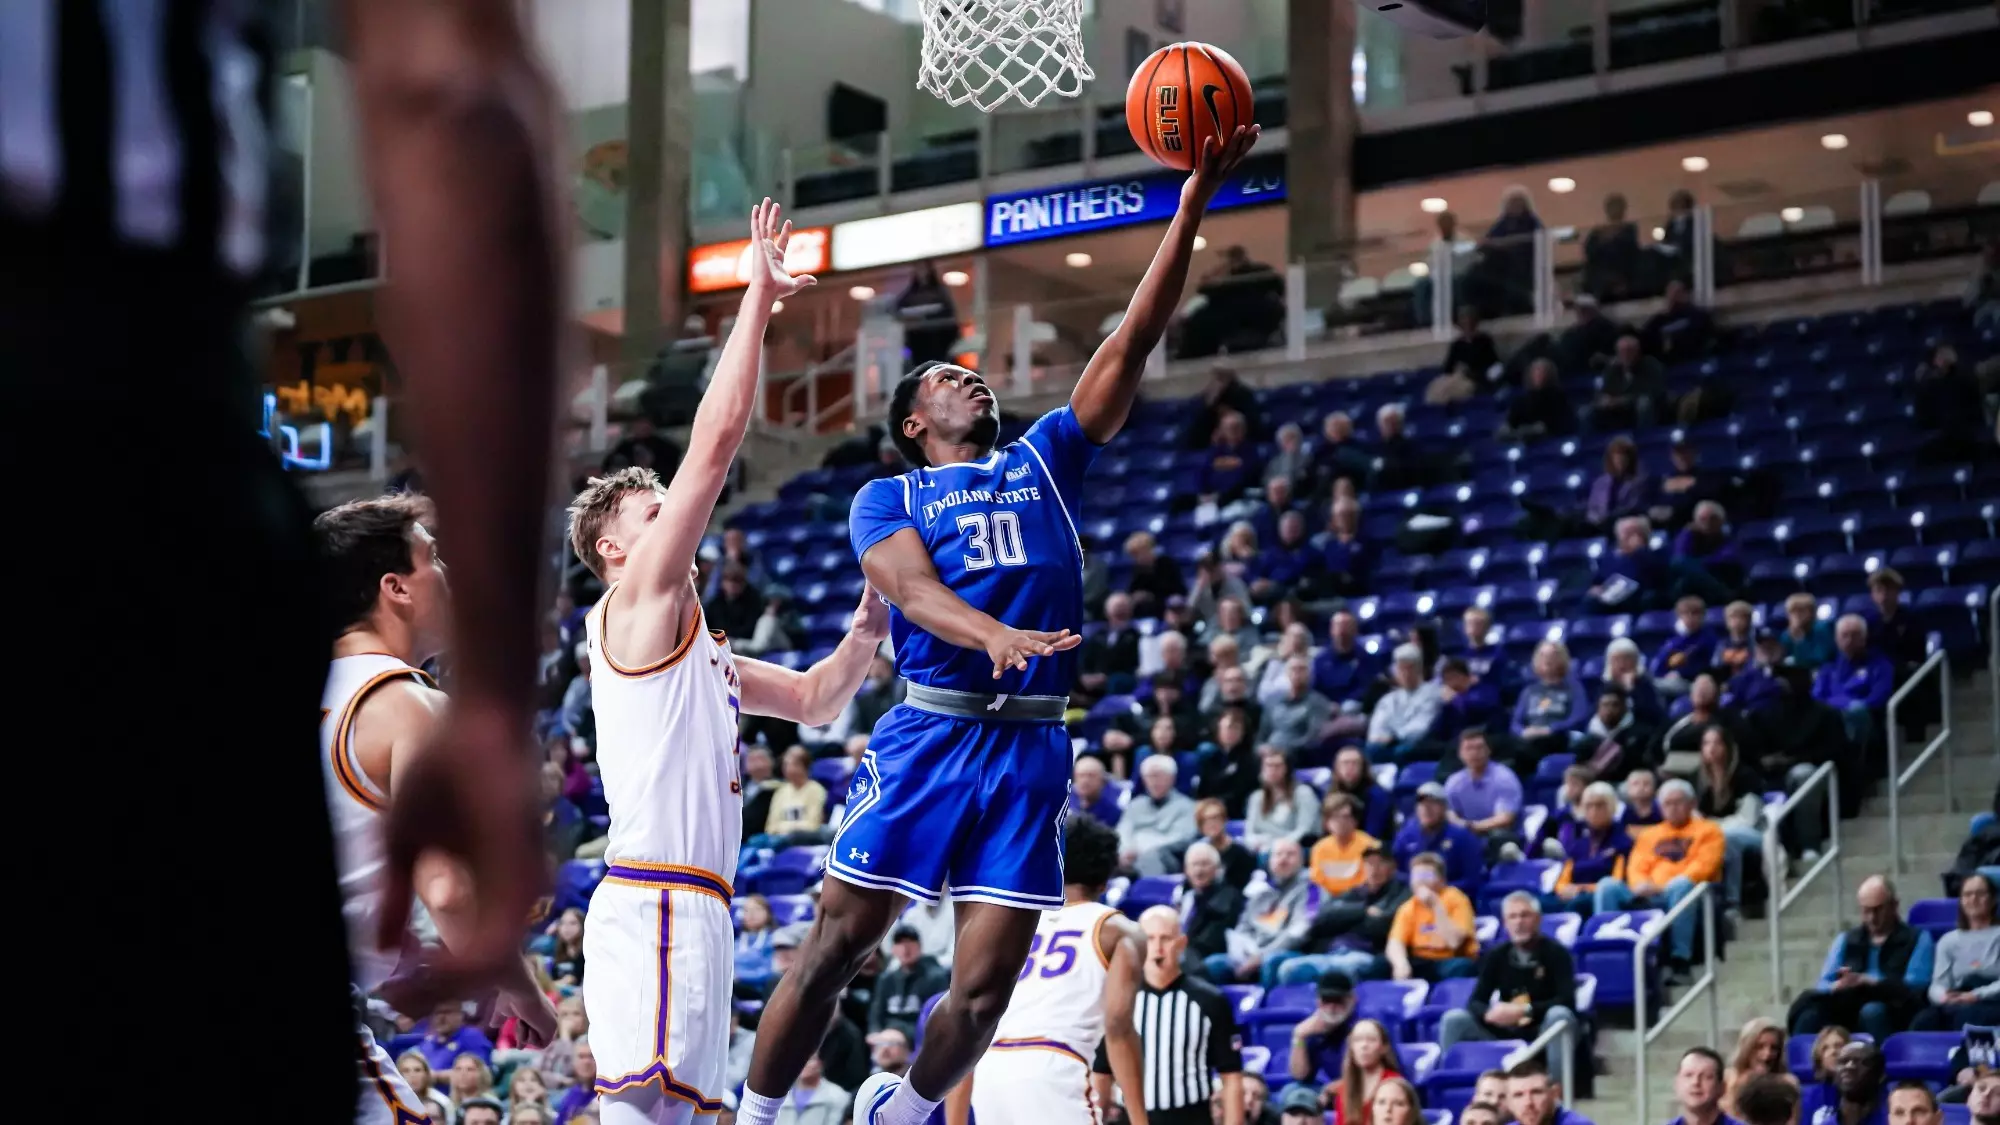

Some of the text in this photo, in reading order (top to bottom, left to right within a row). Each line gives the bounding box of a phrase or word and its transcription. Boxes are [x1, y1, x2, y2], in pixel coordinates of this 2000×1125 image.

[1160, 85, 1184, 151] ELITE
[990, 180, 1145, 236] PANTHERS
[925, 486, 1041, 519] INDIANA STATE
[956, 510, 1028, 571] 30
